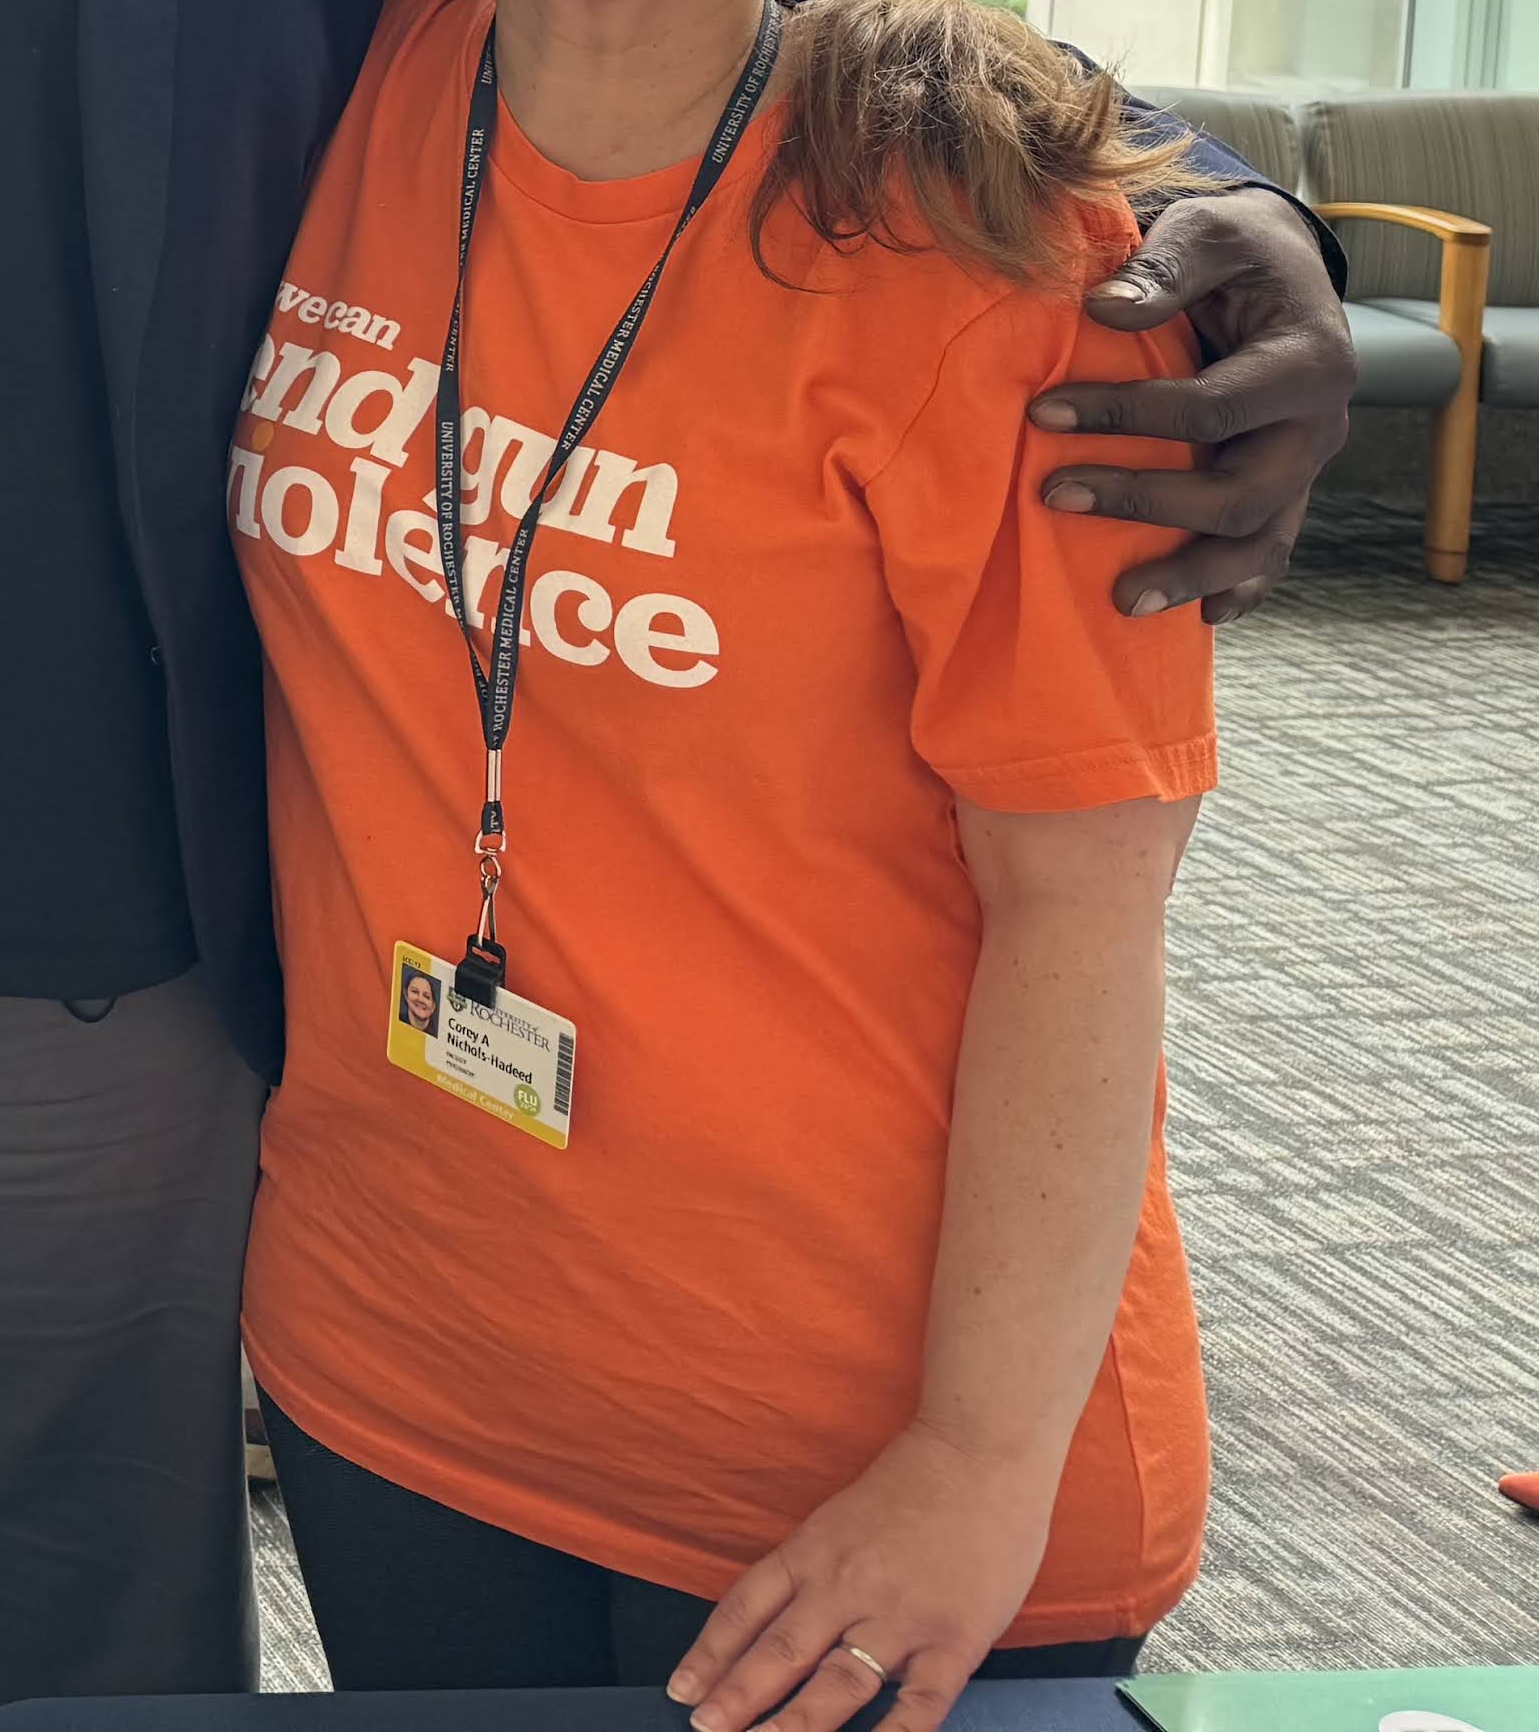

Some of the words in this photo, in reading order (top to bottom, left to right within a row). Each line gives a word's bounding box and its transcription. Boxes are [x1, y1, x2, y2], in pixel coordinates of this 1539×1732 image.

[712, 93, 751, 164] UNIVERSITY
[745, 76, 761, 93] OF
[467, 128, 485, 180] CENTER
[460, 184, 476, 240] MEDICAL
[587, 340, 625, 396] MEDICAL
[561, 398, 595, 450] CENTER
[424, 406, 679, 559] gun
[440, 421, 453, 499] UNIVERSITY
[442, 502, 453, 519] OF
[442, 522, 460, 605] ROCHESTER
[509, 528, 529, 583] CENTER
[500, 587, 517, 649] MEDICAL
[492, 651, 512, 731] ROCHESTER
[448, 1018, 479, 1044] Corey
[480, 1034, 490, 1047] A
[470, 1001, 551, 1053] ROCHESTER
[447, 1033, 533, 1085] Nichols-Hadeed
[436, 1072, 477, 1102] Medical
[479, 1094, 515, 1120] Center
[518, 1090, 537, 1107] FLU
